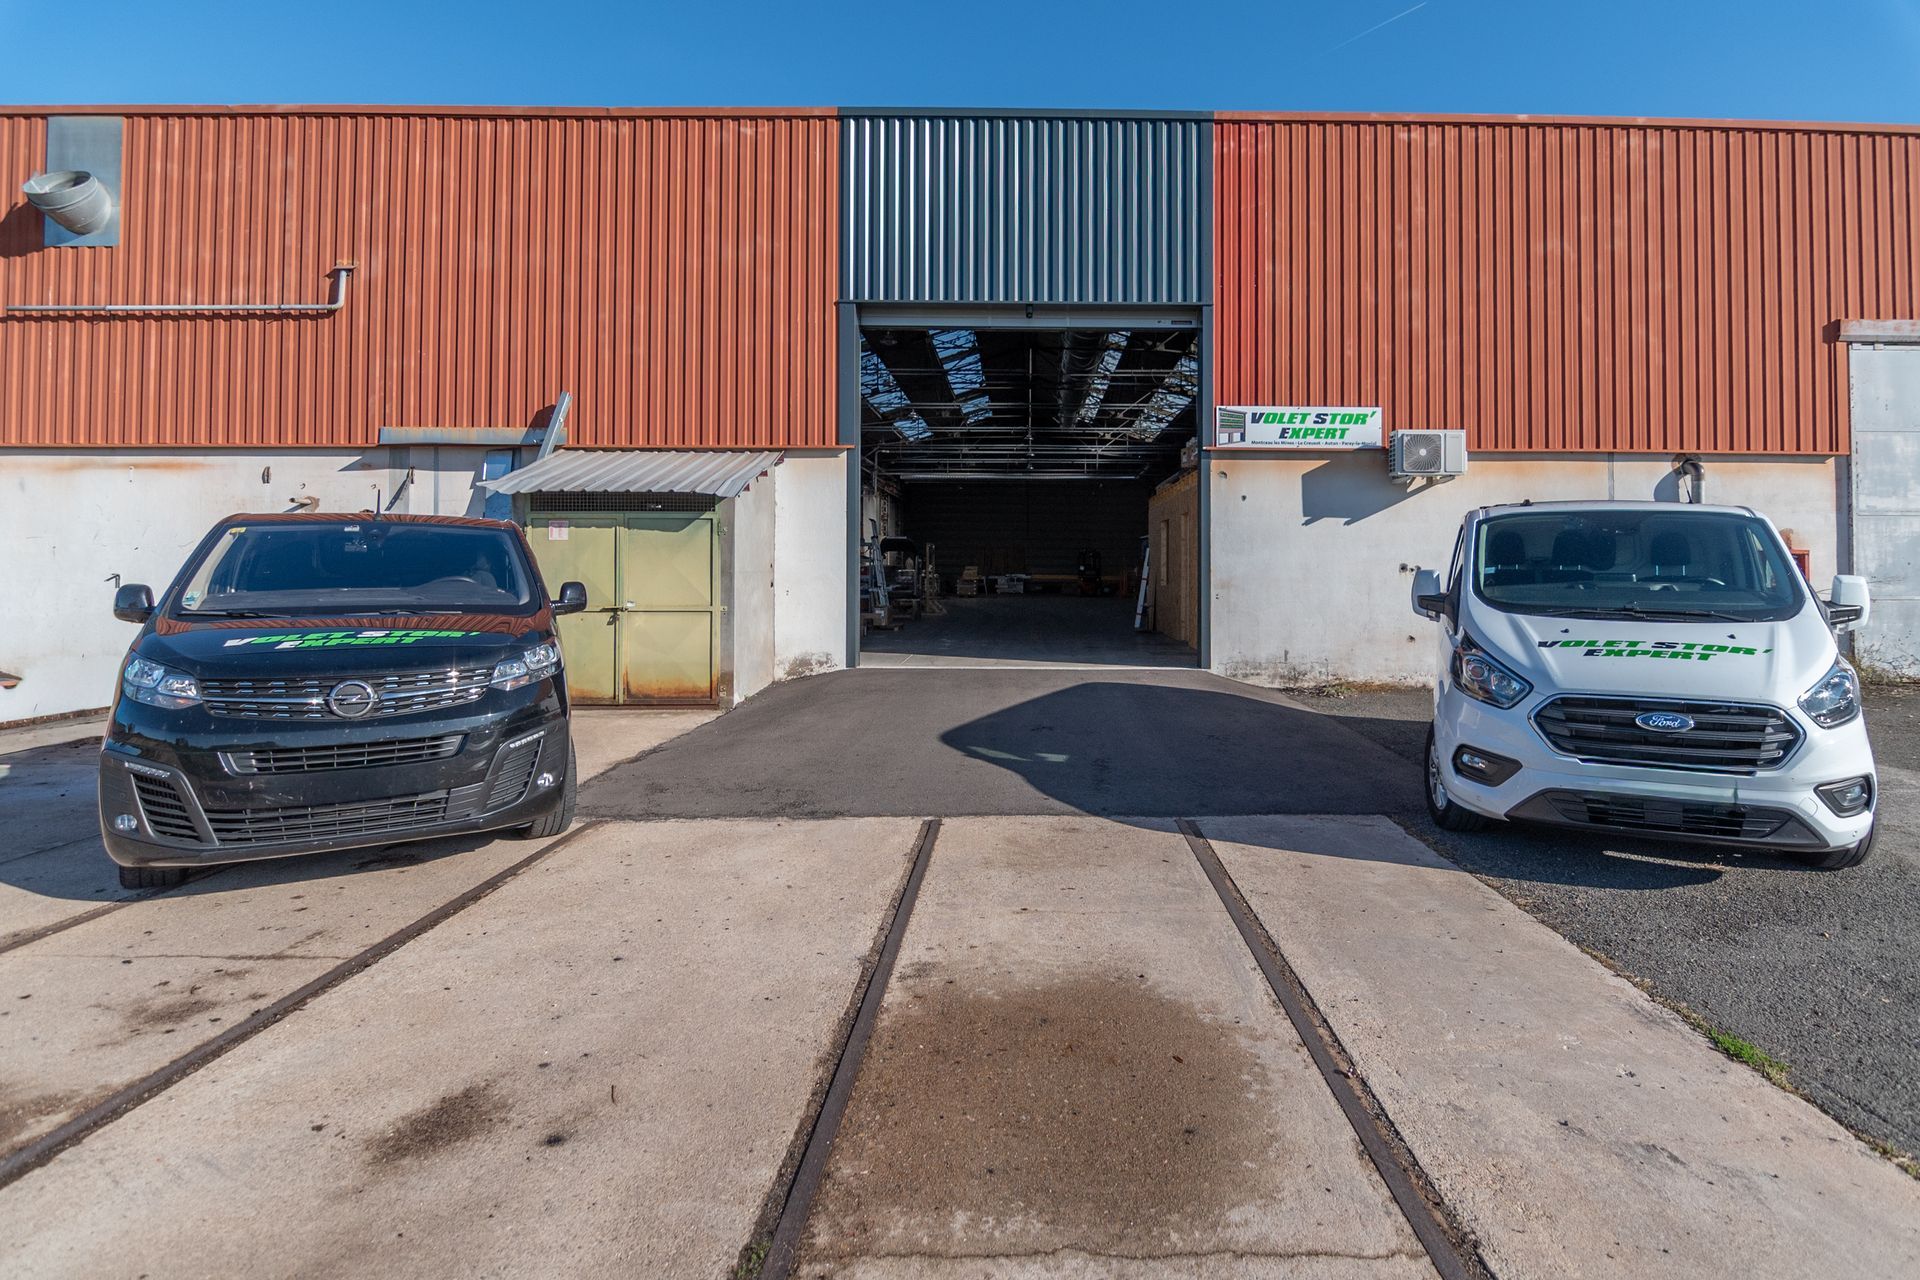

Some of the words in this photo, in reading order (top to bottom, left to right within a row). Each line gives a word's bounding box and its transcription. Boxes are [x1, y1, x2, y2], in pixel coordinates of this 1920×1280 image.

[1250, 412, 1311, 425] VOLET
[1313, 410, 1377, 425] STOR'
[1278, 427, 1349, 440] EXPERT
[223, 631, 356, 648] VOLET
[274, 636, 423, 650] EXPERT
[1537, 640, 1647, 649] VOLET
[1650, 641, 1774, 655] STOR'
[1582, 648, 1718, 662] EXPERT
[1650, 714, 1681, 728] Ford
